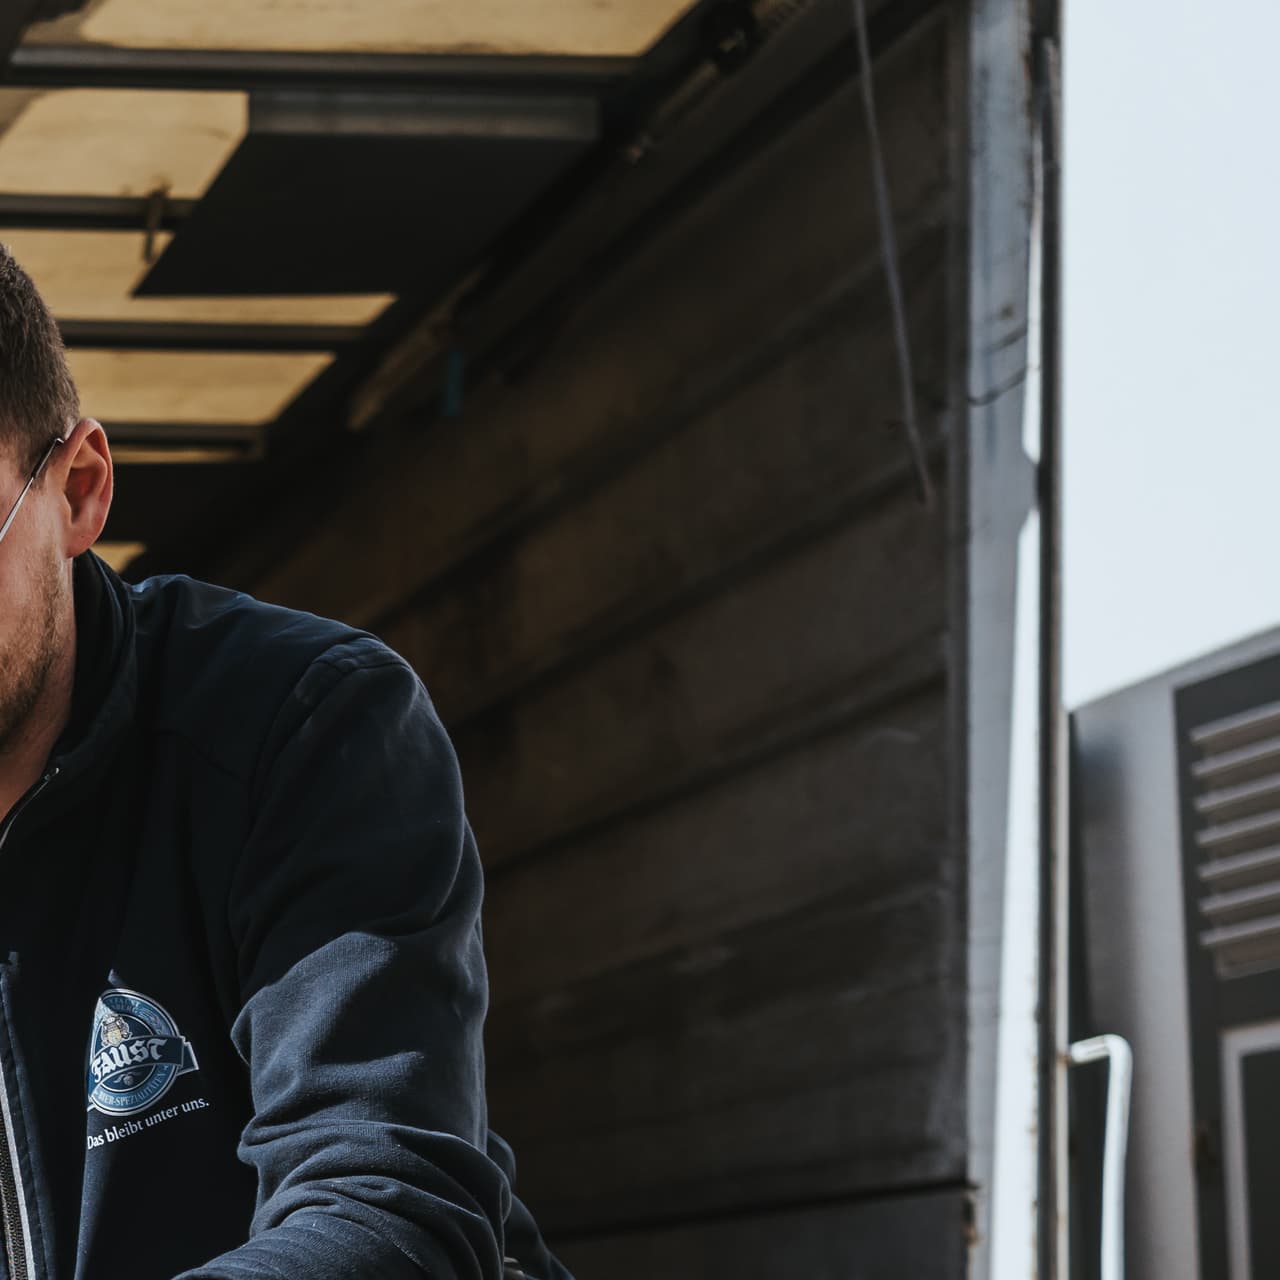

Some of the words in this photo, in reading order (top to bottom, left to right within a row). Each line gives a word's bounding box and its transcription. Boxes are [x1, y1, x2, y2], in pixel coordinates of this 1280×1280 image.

[92, 1038, 168, 1083] FAUST
[87, 1133, 104, 1150] Das
[104, 1118, 144, 1143] bleibt
[145, 1104, 179, 1128] unter
[182, 1098, 210, 1113] uns.
